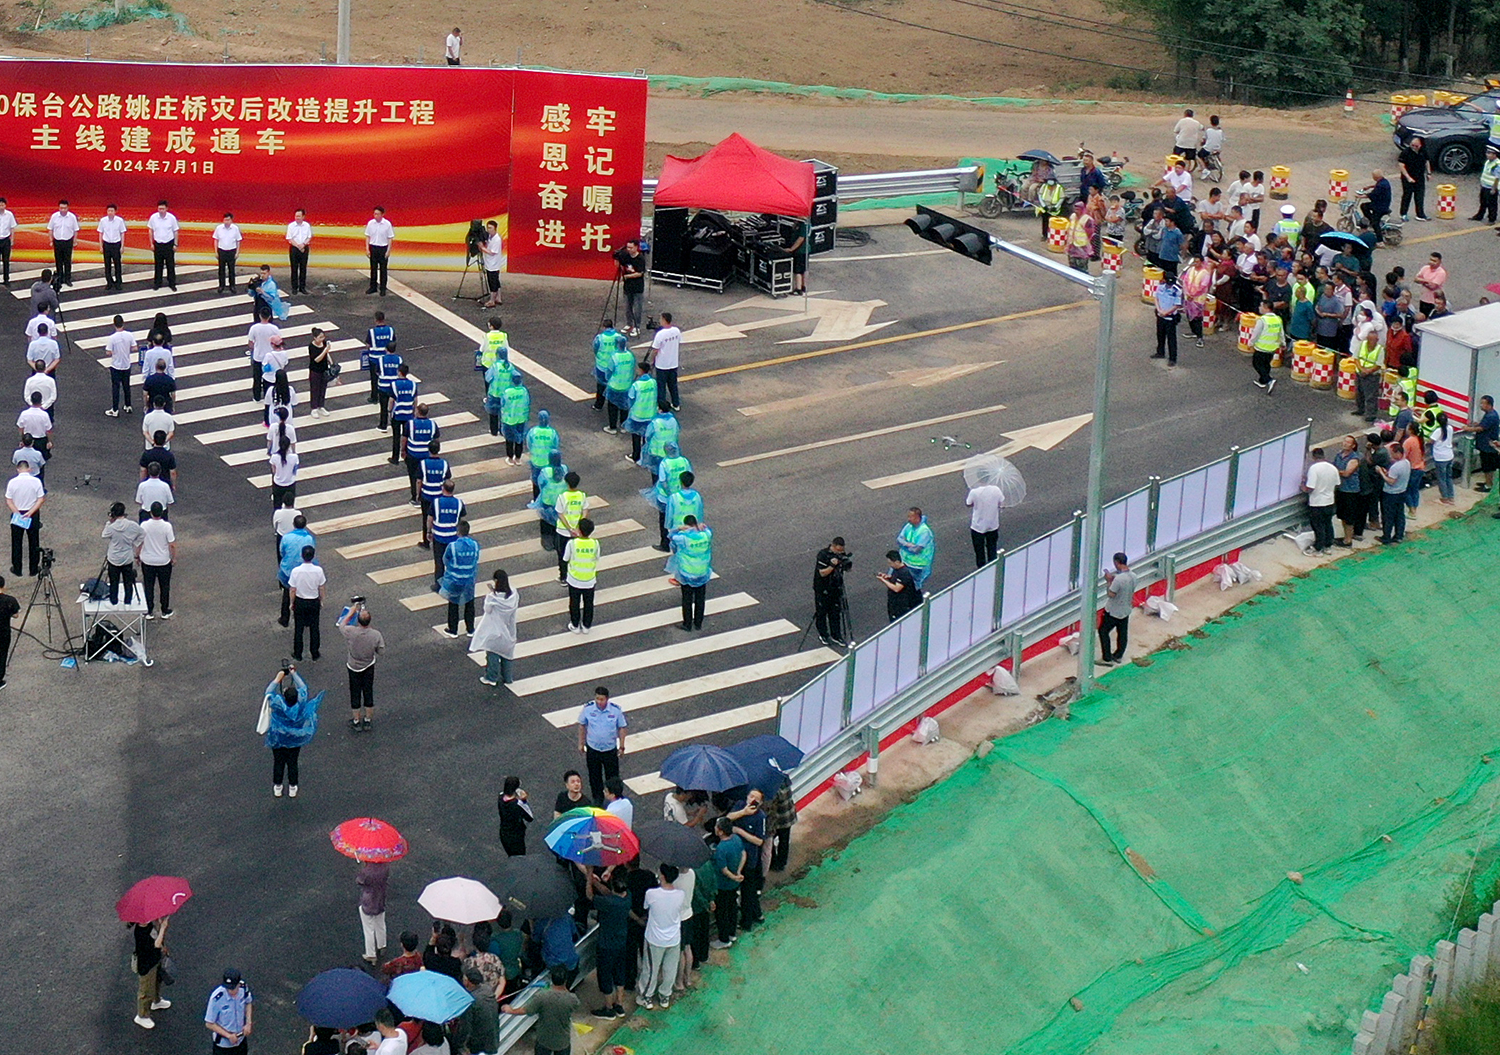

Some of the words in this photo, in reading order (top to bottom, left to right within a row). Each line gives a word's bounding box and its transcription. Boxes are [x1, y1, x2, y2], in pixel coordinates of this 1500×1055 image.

[30, 123, 287, 155] 主线建成通车
[102, 158, 215, 175] 2024年7月1日
[535, 102, 572, 249] 感恩奋进
[580, 105, 617, 253] 牢记嘱托
